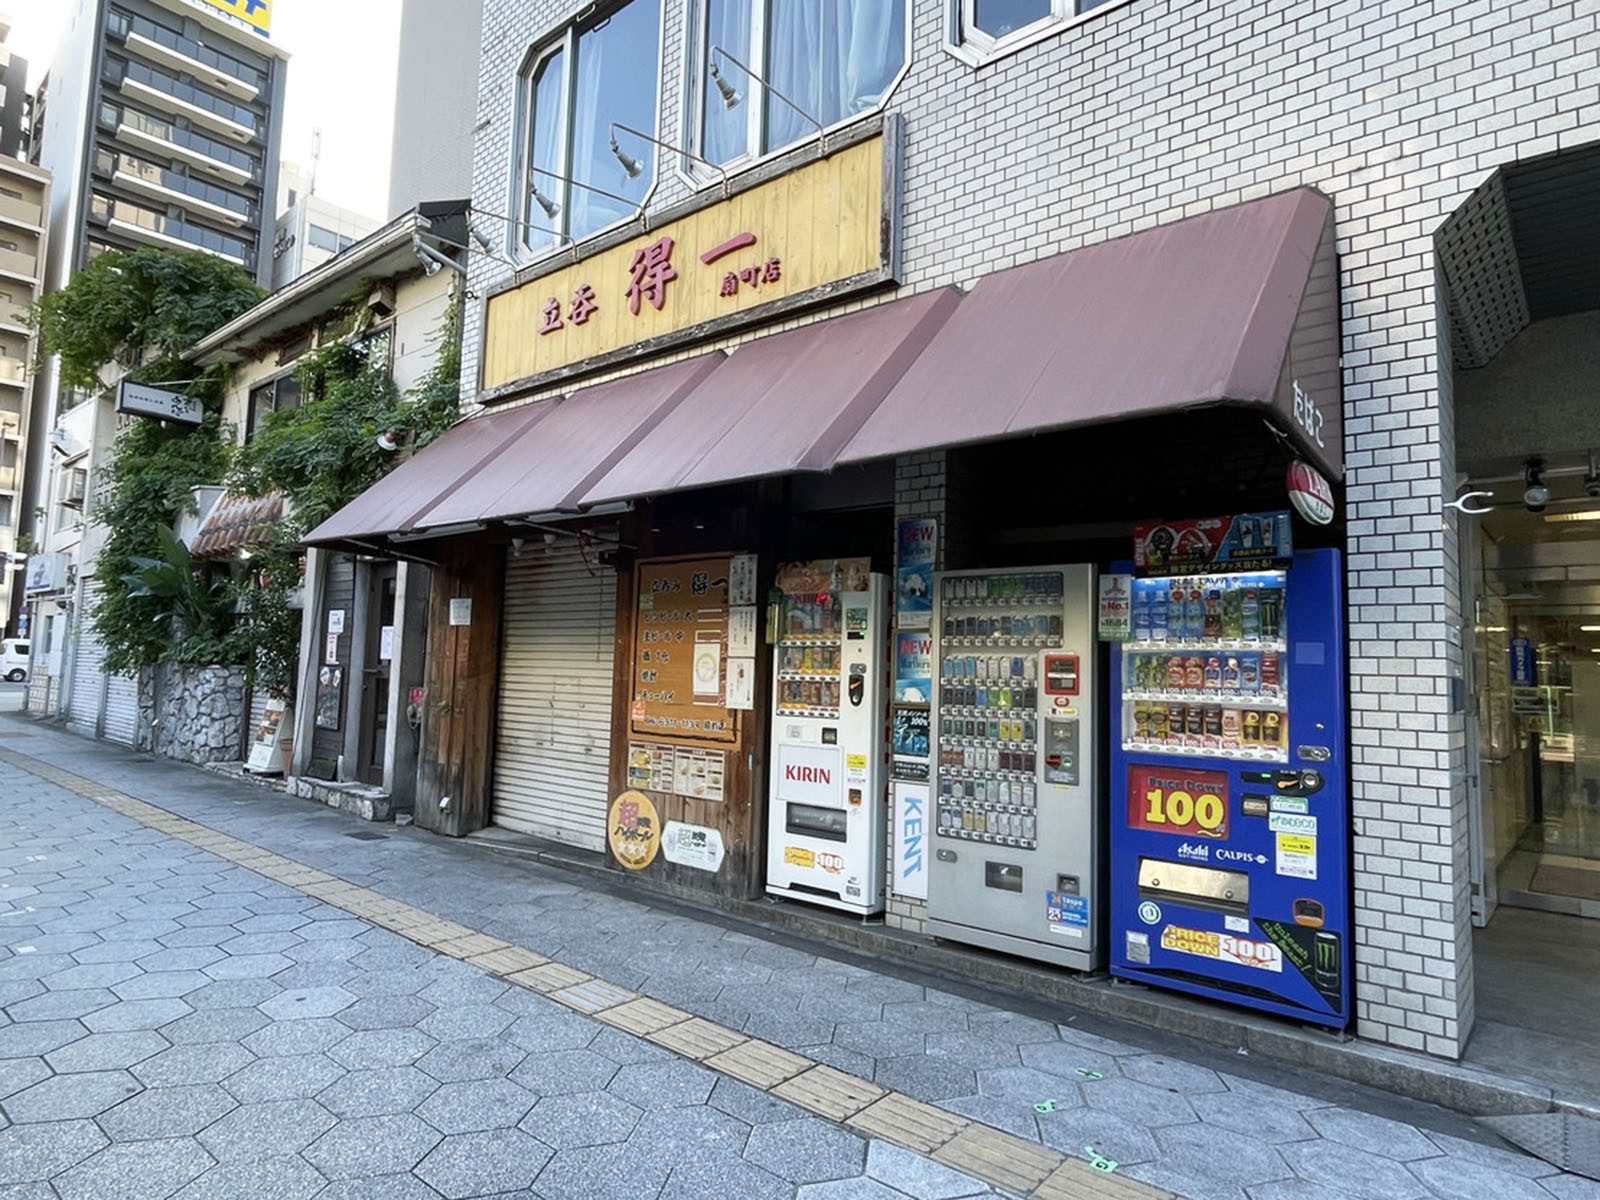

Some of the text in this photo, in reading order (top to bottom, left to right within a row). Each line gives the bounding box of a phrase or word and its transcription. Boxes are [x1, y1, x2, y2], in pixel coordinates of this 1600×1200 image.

[537, 231, 757, 335] 立呑 得一
[719, 257, 782, 298] 扇町店
[1292, 379, 1325, 449] たばこ
[901, 639, 933, 655] NEW
[785, 764, 831, 785] KIRIN
[1147, 776, 1225, 793] PRICE DOWN
[1146, 788, 1225, 830] 100
[903, 796, 923, 878] KENT
[1177, 842, 1254, 862] Asahi CALPIS
[1164, 937, 1220, 957] DOWN
[1168, 926, 1220, 946] PRICE
[1223, 937, 1273, 961] 100
